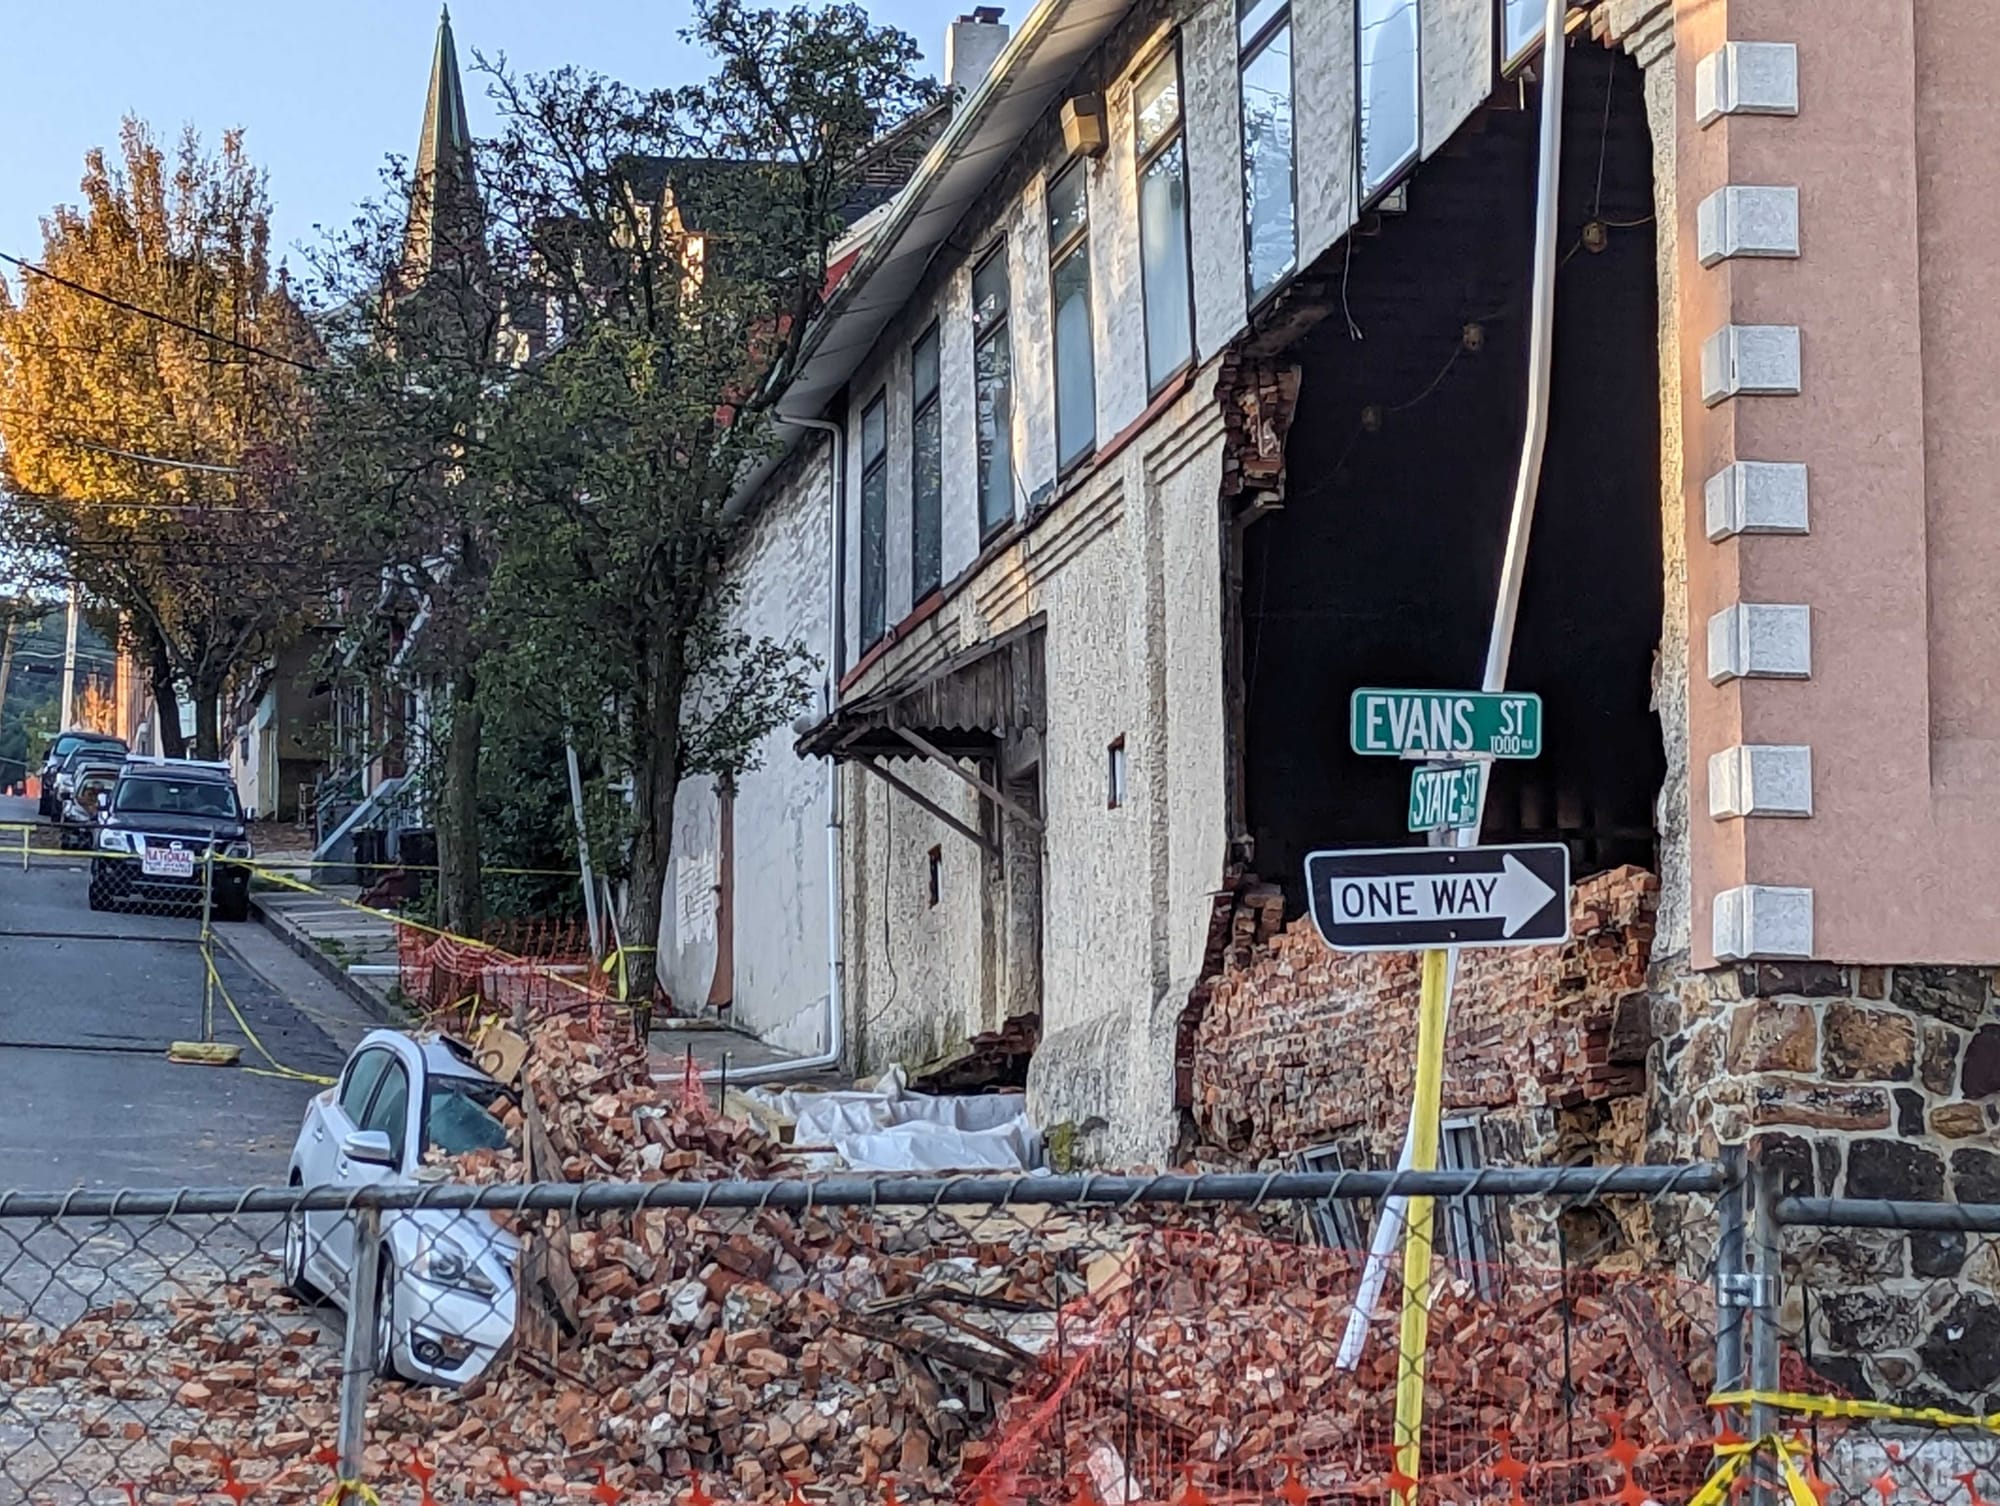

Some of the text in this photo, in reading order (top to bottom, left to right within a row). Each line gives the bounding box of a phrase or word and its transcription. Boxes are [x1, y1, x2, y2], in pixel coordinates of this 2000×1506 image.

[1366, 697, 1527, 750] EVANS ST
[1490, 736, 1520, 753] 1000
[1413, 768, 1478, 825] STATE ST
[1342, 877, 1498, 918] ONE WAY
